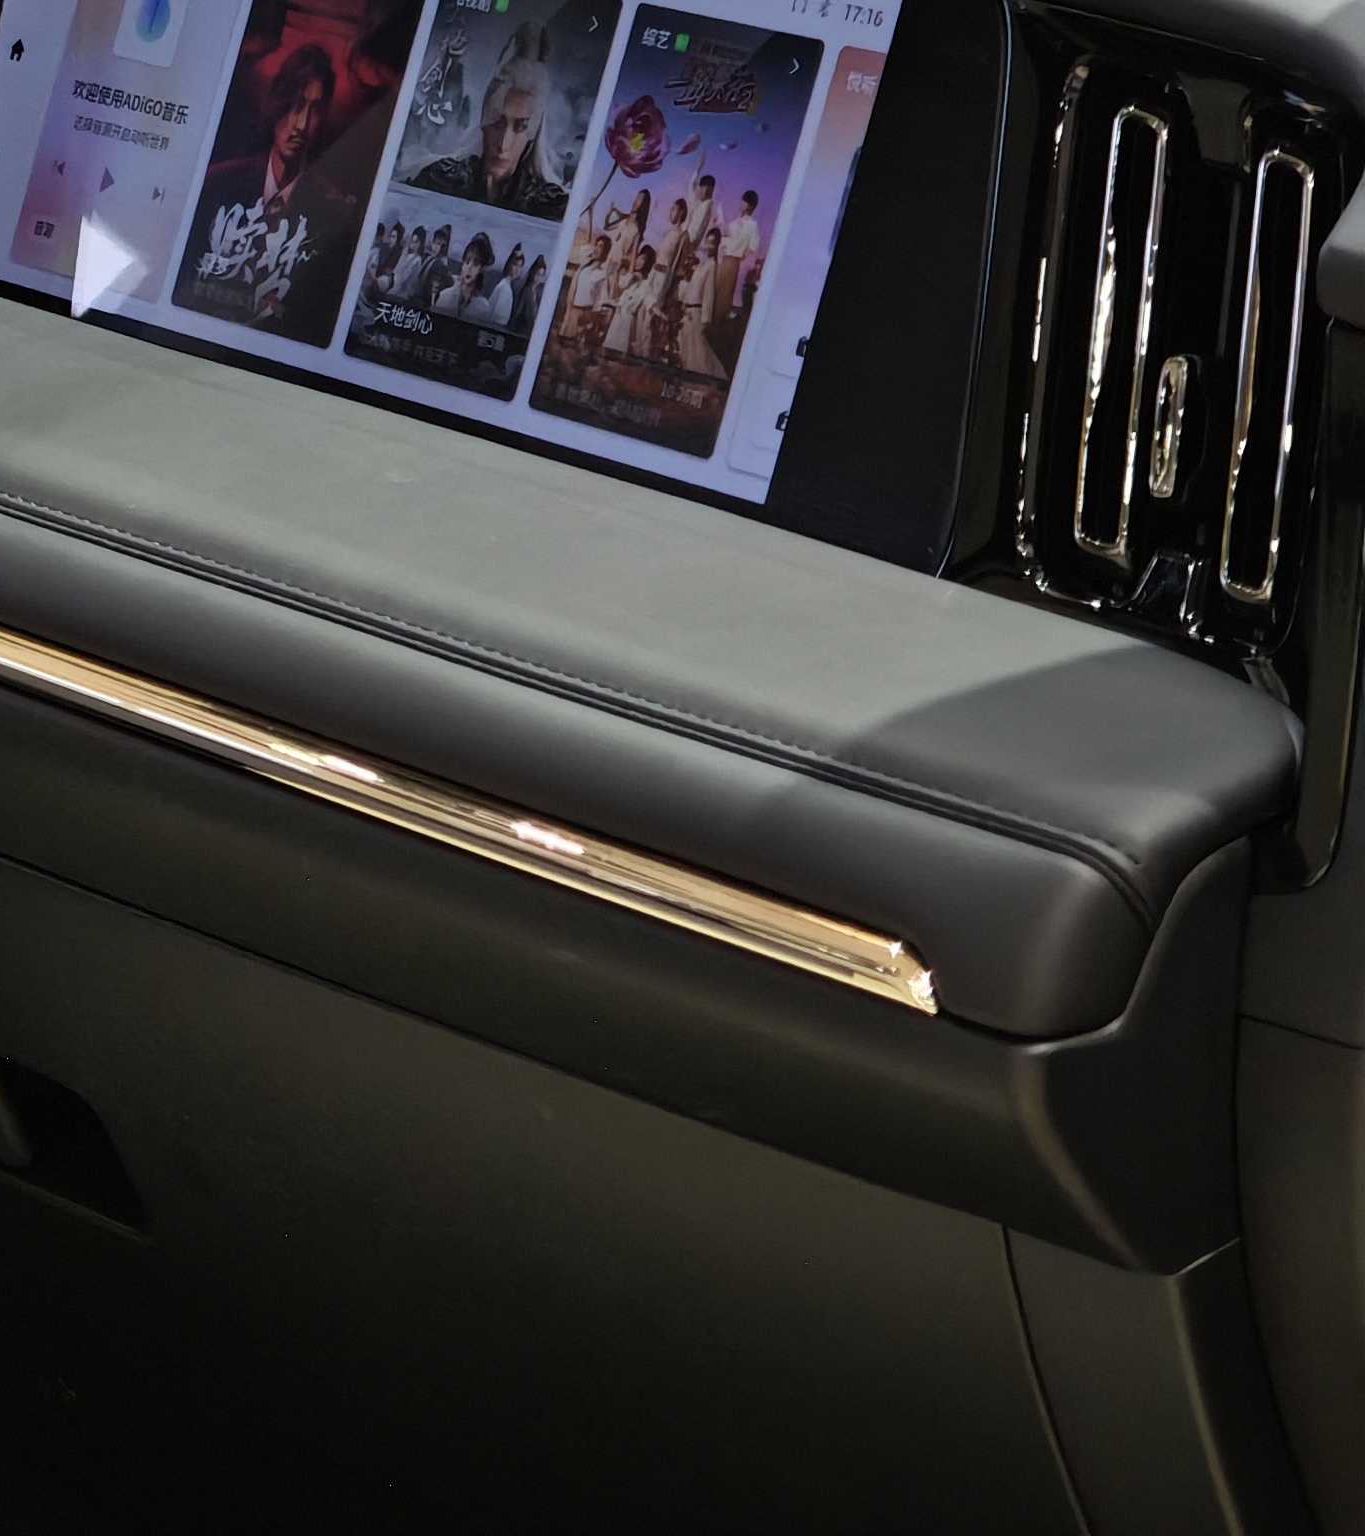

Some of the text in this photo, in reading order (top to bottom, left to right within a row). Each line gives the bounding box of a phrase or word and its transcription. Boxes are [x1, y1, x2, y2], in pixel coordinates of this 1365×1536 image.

[844, 3, 884, 27] 17:16
[640, 25, 672, 51] 综艺
[71, 79, 190, 125] 欢迎使用ADiGO音乐
[373, 301, 434, 335] 天地剑心
